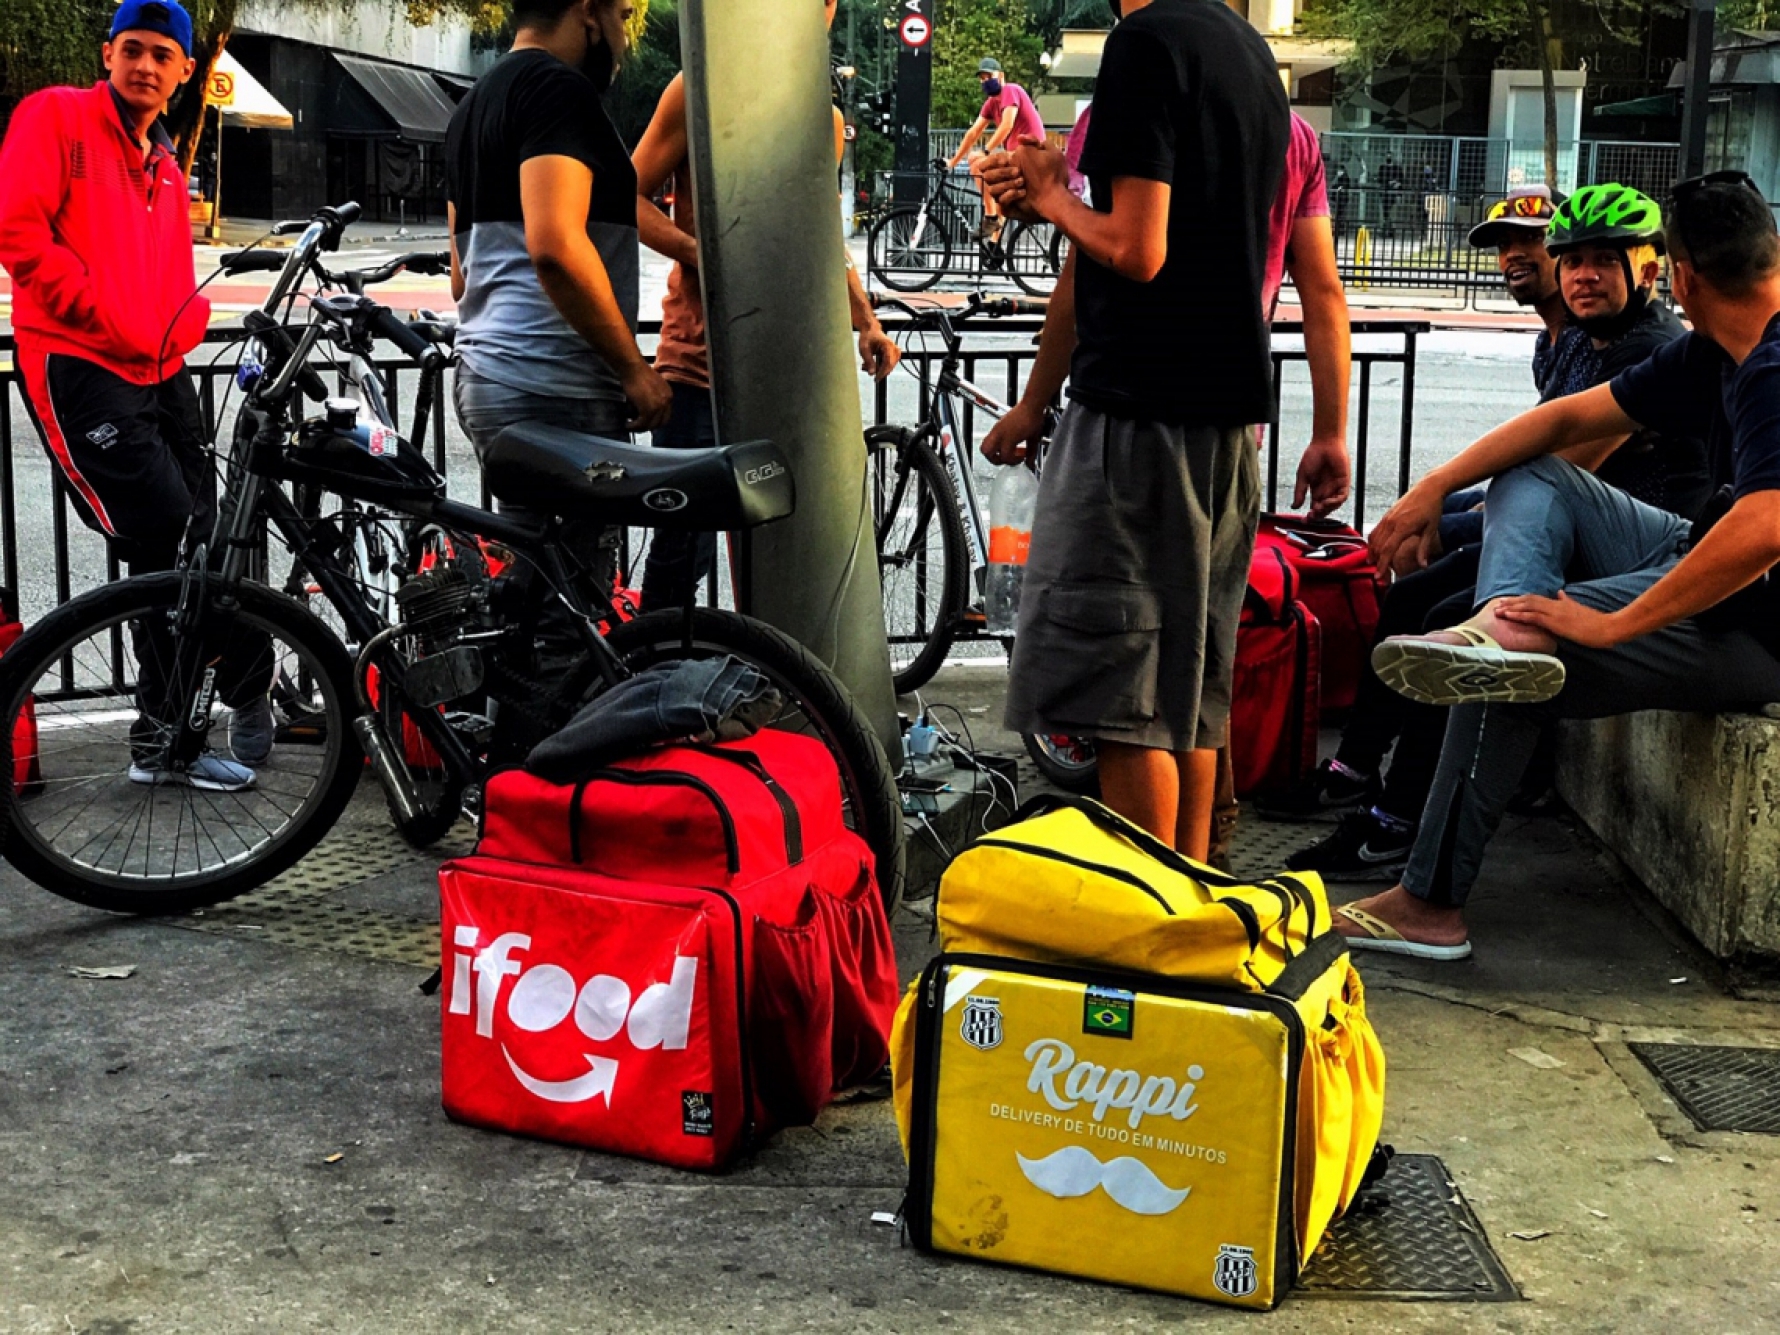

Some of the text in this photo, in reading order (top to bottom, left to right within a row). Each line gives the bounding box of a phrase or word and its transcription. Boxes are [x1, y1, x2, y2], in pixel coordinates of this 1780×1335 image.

[1561, 50, 1683, 74] NotreDam
[945, 452, 961, 499] Khatay
[961, 515, 978, 563] Khatay
[1023, 1038, 1205, 1129] Rappi
[990, 1103, 1227, 1165] DELIVERY DE TUDO EM MINUTOS
